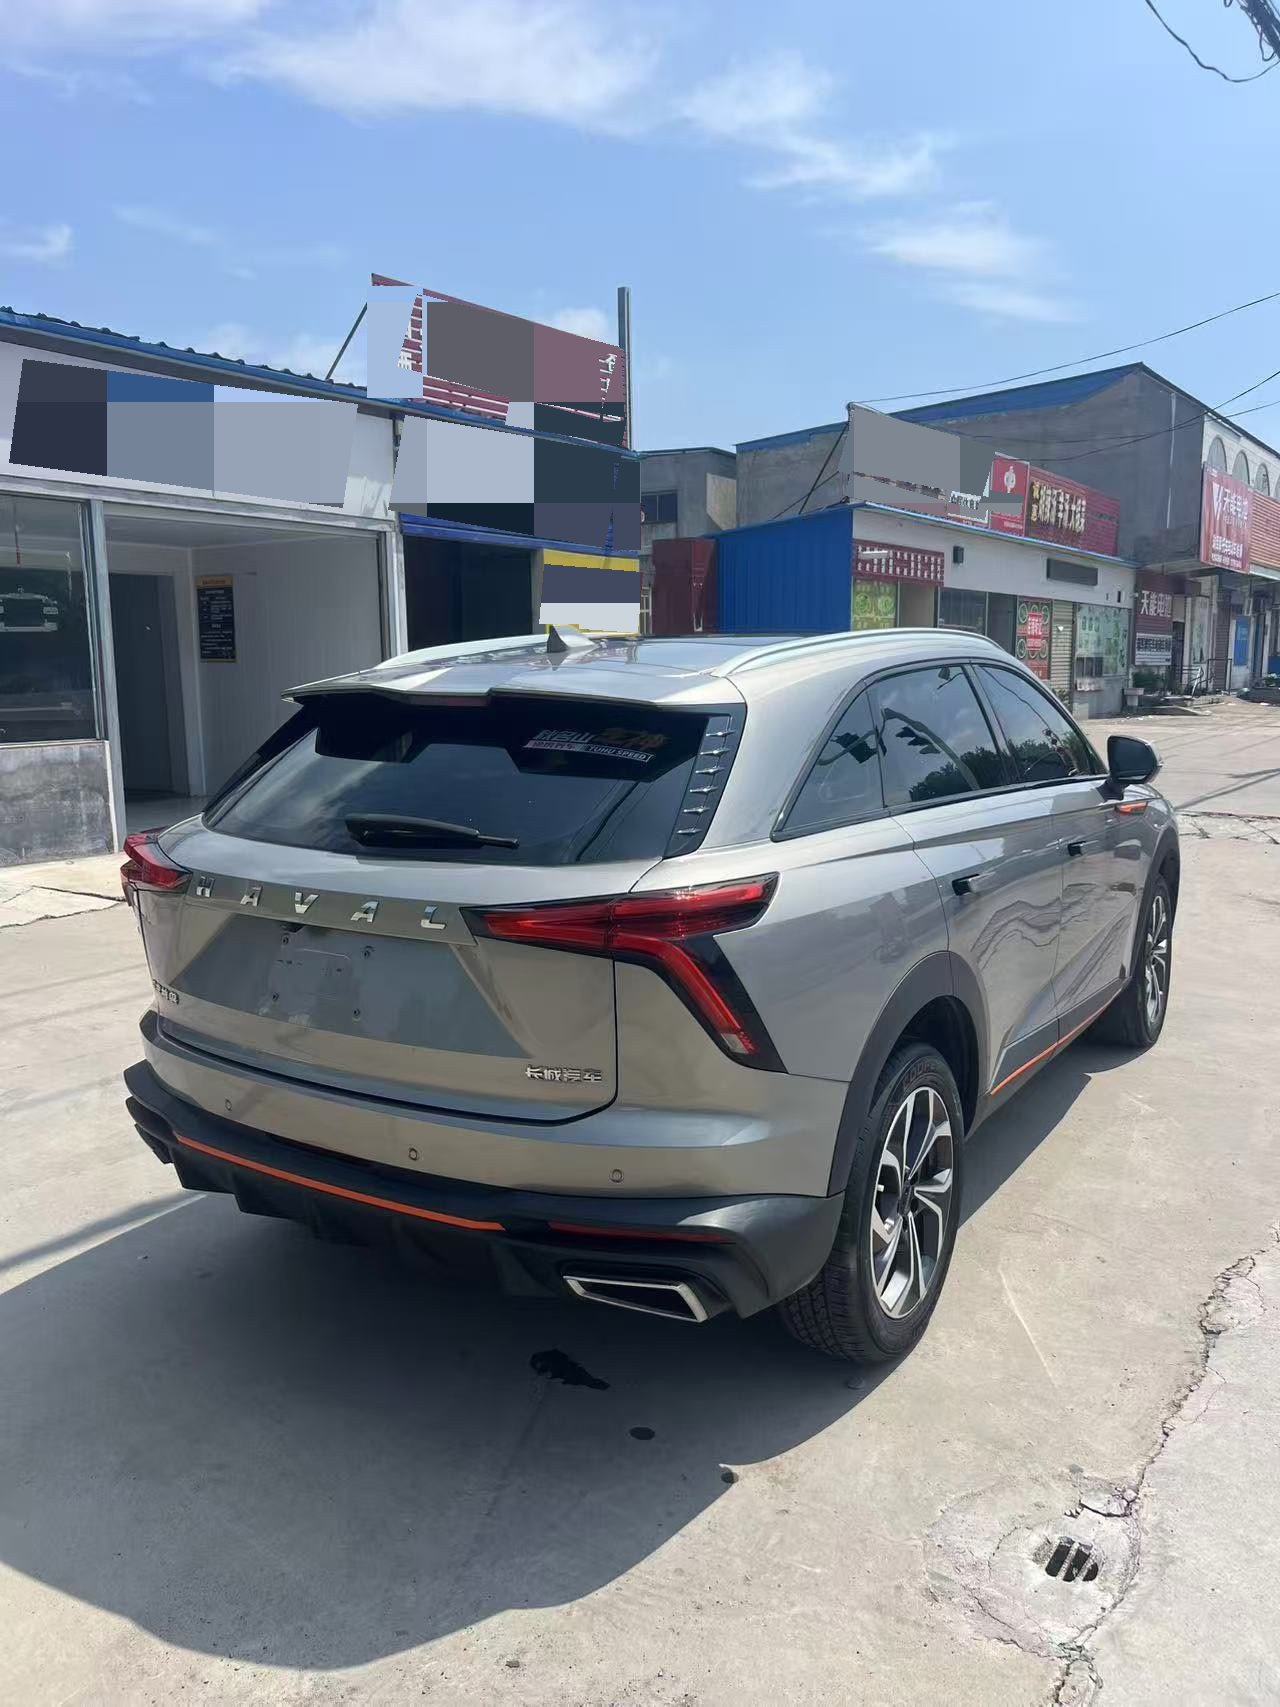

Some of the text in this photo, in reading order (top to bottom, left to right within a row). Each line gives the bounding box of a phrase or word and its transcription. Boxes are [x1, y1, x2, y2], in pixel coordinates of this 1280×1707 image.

[616, 748, 648, 761] SPEED
[196, 875, 448, 930] HAVAL
[525, 1066, 602, 1083] 长城汽车
